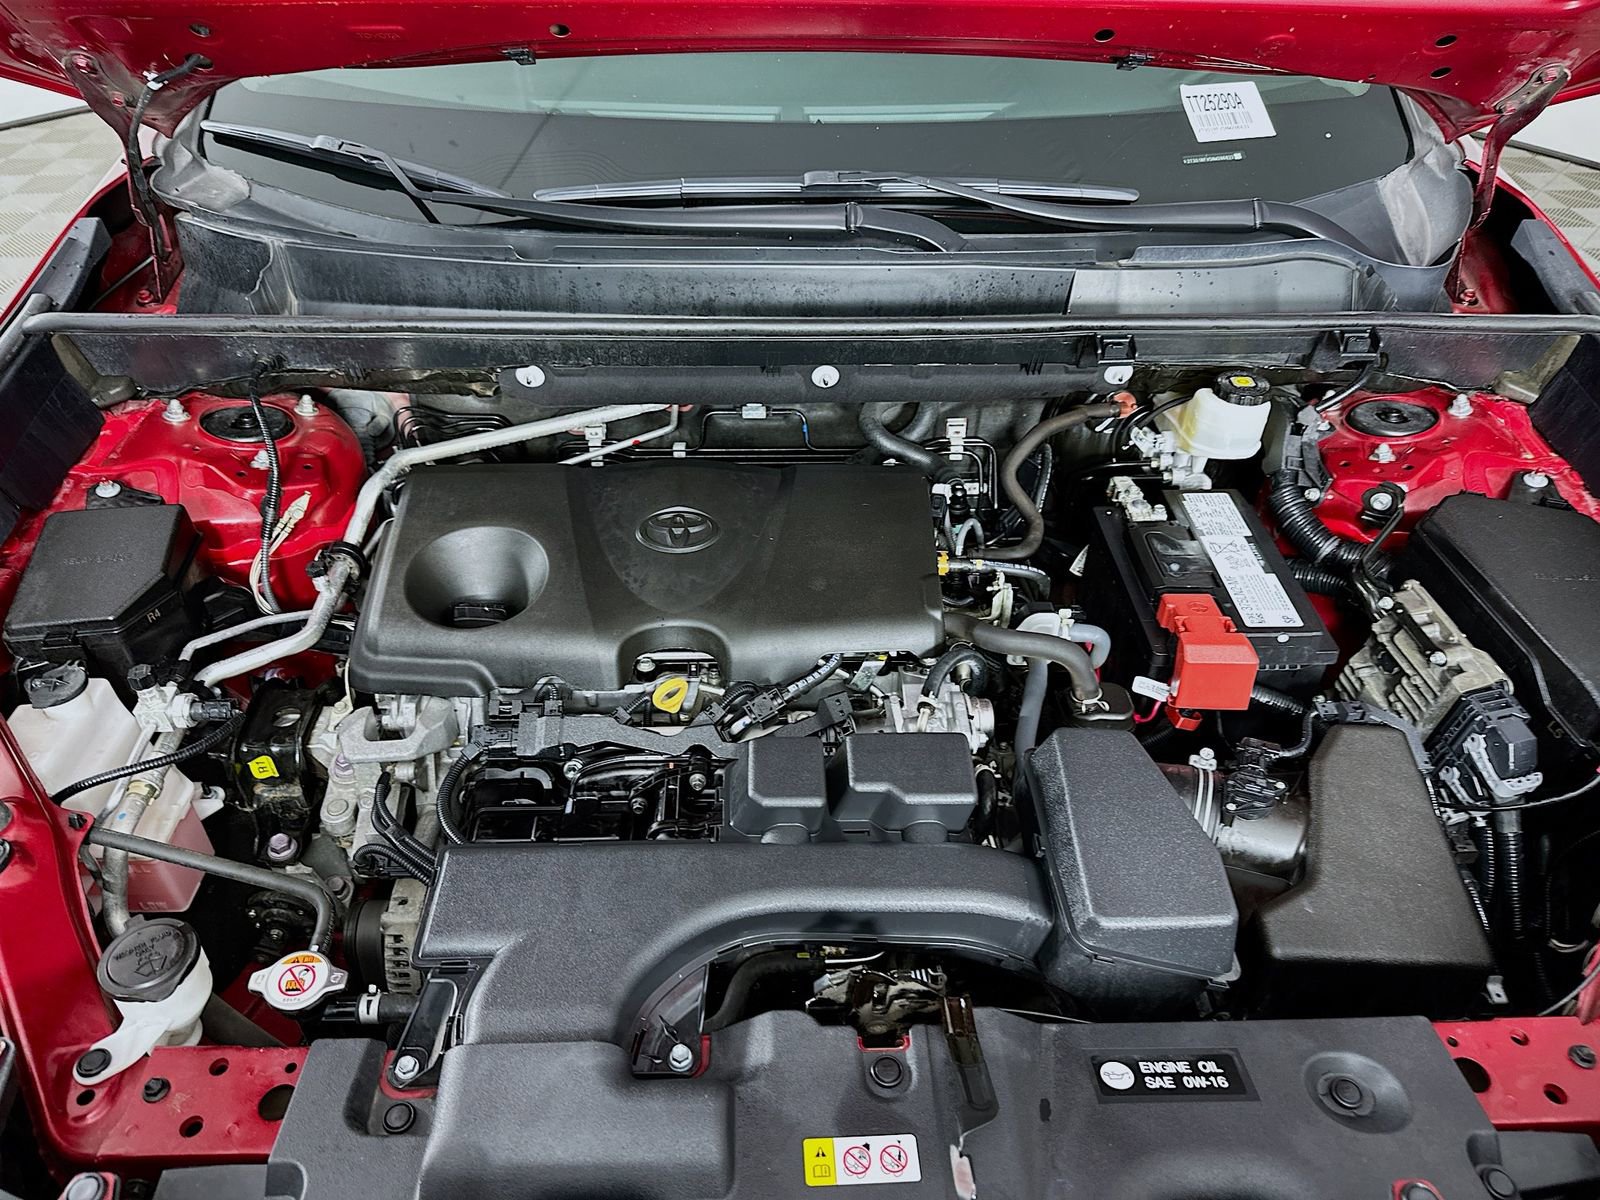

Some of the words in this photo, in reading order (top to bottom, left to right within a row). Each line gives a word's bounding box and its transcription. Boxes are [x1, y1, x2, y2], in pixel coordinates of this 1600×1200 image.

[1186, 92, 1245, 112] TT25290A
[146, 608, 161, 623] R4
[1138, 1061, 1193, 1074] ENGINE
[1197, 1061, 1224, 1073] OIL
[1144, 1076, 1177, 1089] SAE
[1182, 1075, 1230, 1088] 0W-16
